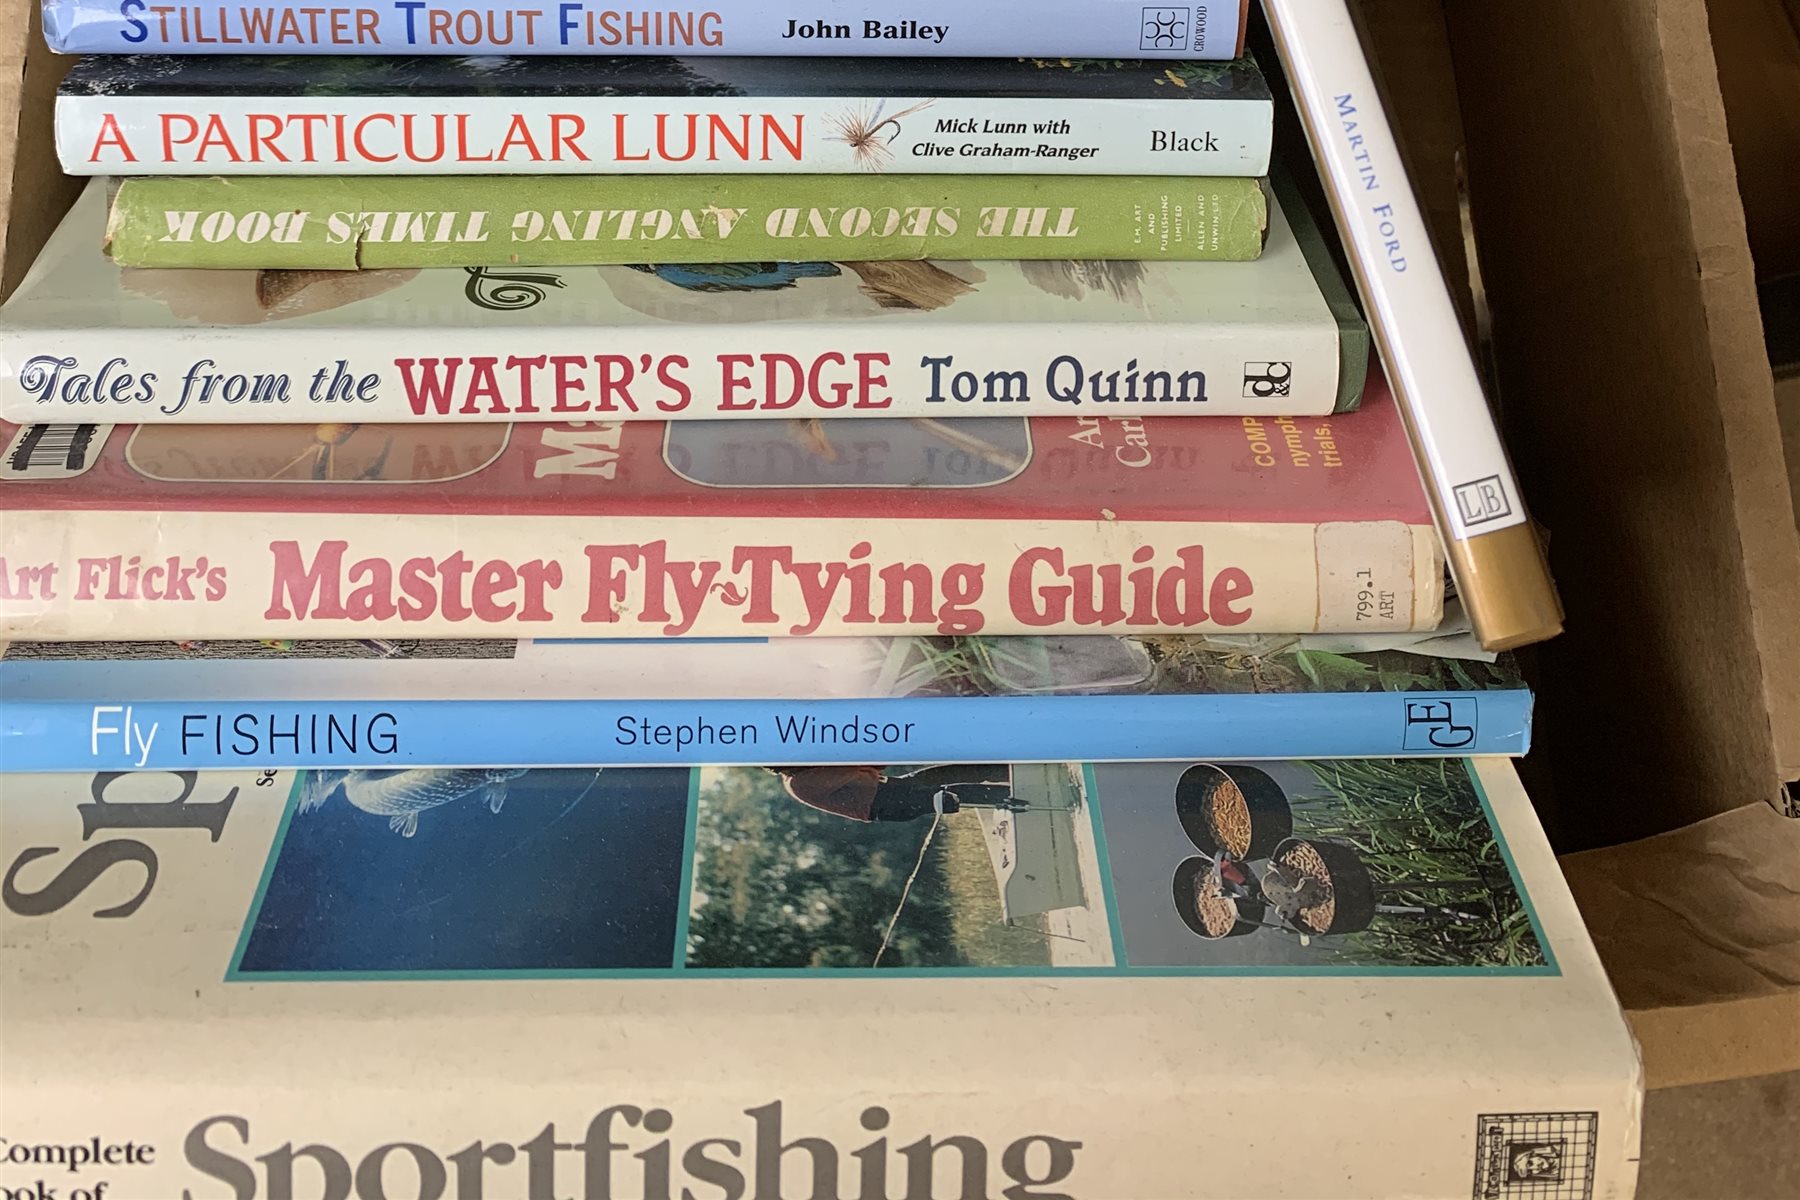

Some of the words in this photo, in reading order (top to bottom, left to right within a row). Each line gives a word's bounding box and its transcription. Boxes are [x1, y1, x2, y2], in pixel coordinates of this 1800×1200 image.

[781, 18, 852, 41] John
[861, 19, 950, 44] Bailey
[1194, 5, 1208, 52] CROWOOD
[87, 112, 139, 164] A
[158, 111, 591, 164] PARTICULAR
[612, 112, 806, 162] LUNN
[934, 118, 976, 136] Mick
[980, 118, 1028, 136] Lunn
[1031, 118, 1071, 136] with
[1149, 129, 1220, 154] Black
[911, 142, 955, 159] Clive
[957, 142, 1100, 161] Graham-Ranger
[765, 206, 961, 239] SECOND
[976, 206, 1081, 238] THE
[1160, 194, 1169, 252] PUBLISHING
[1174, 204, 1183, 242] LIMITED
[1197, 194, 1206, 217] AND
[158, 210, 311, 244] BOOK
[325, 210, 491, 244] TIMES
[511, 206, 749, 243] ANGLING
[1147, 212, 1156, 235] AND
[1197, 221, 1206, 251] ALLEN
[1211, 216, 1219, 252] UNWIN
[19, 354, 158, 405] Tales
[160, 358, 292, 415] from
[307, 360, 381, 405] the
[394, 353, 692, 415] WATER'S
[716, 351, 893, 411] EDGE
[920, 355, 1031, 403] Tom
[1045, 355, 1209, 406] Quinn
[0, 556, 58, 601] Art
[73, 554, 229, 602] Flick's
[263, 539, 564, 623] Master
[1007, 544, 1255, 628] Guide
[1356, 567, 1372, 622] 799.1
[1379, 590, 1395, 620] ART
[90, 704, 159, 768] Fly
[181, 711, 400, 756] FISHING
[614, 714, 759, 753] Stephen
[774, 714, 917, 745] Windsor
[183, 1101, 1083, 1200] Sportfishing
